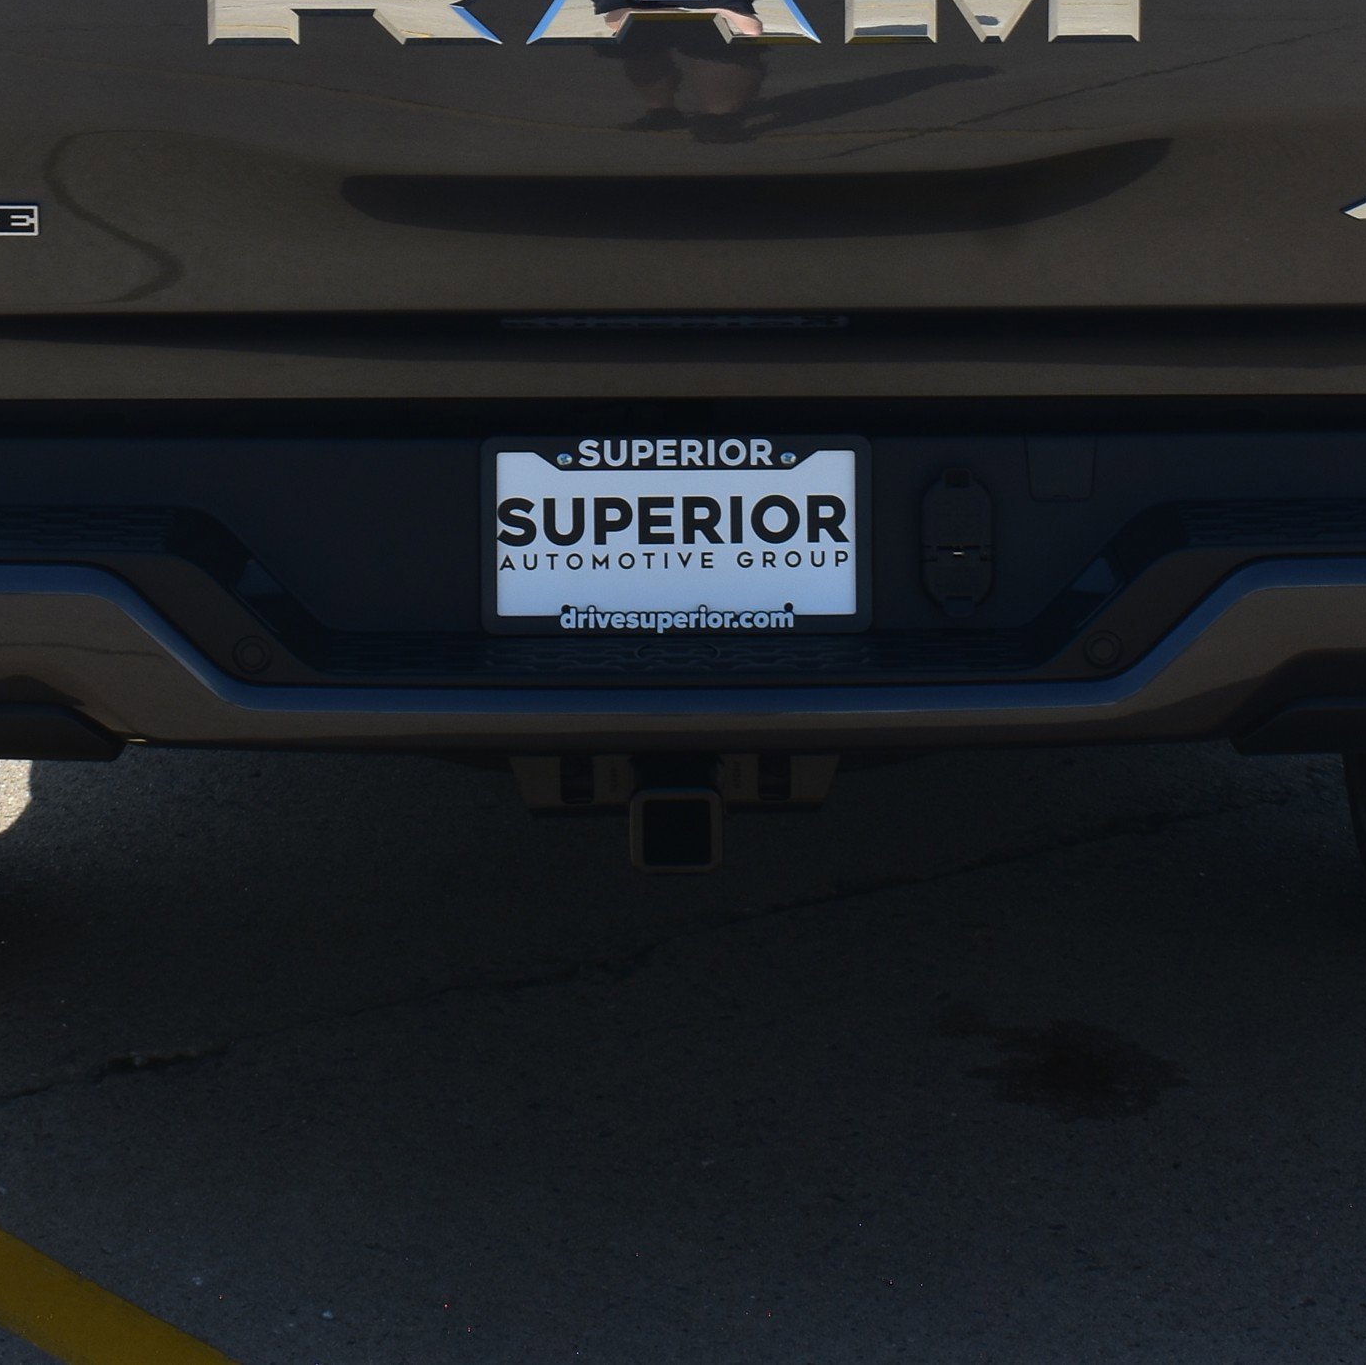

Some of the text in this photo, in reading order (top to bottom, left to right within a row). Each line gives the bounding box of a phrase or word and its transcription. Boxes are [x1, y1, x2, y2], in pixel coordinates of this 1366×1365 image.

[577, 438, 775, 468] SUPERIOR
[496, 493, 851, 547] SUPERIOR
[499, 549, 850, 572] AUTOMOTIVE GROUP
[558, 605, 795, 634] drivesuperior.com
